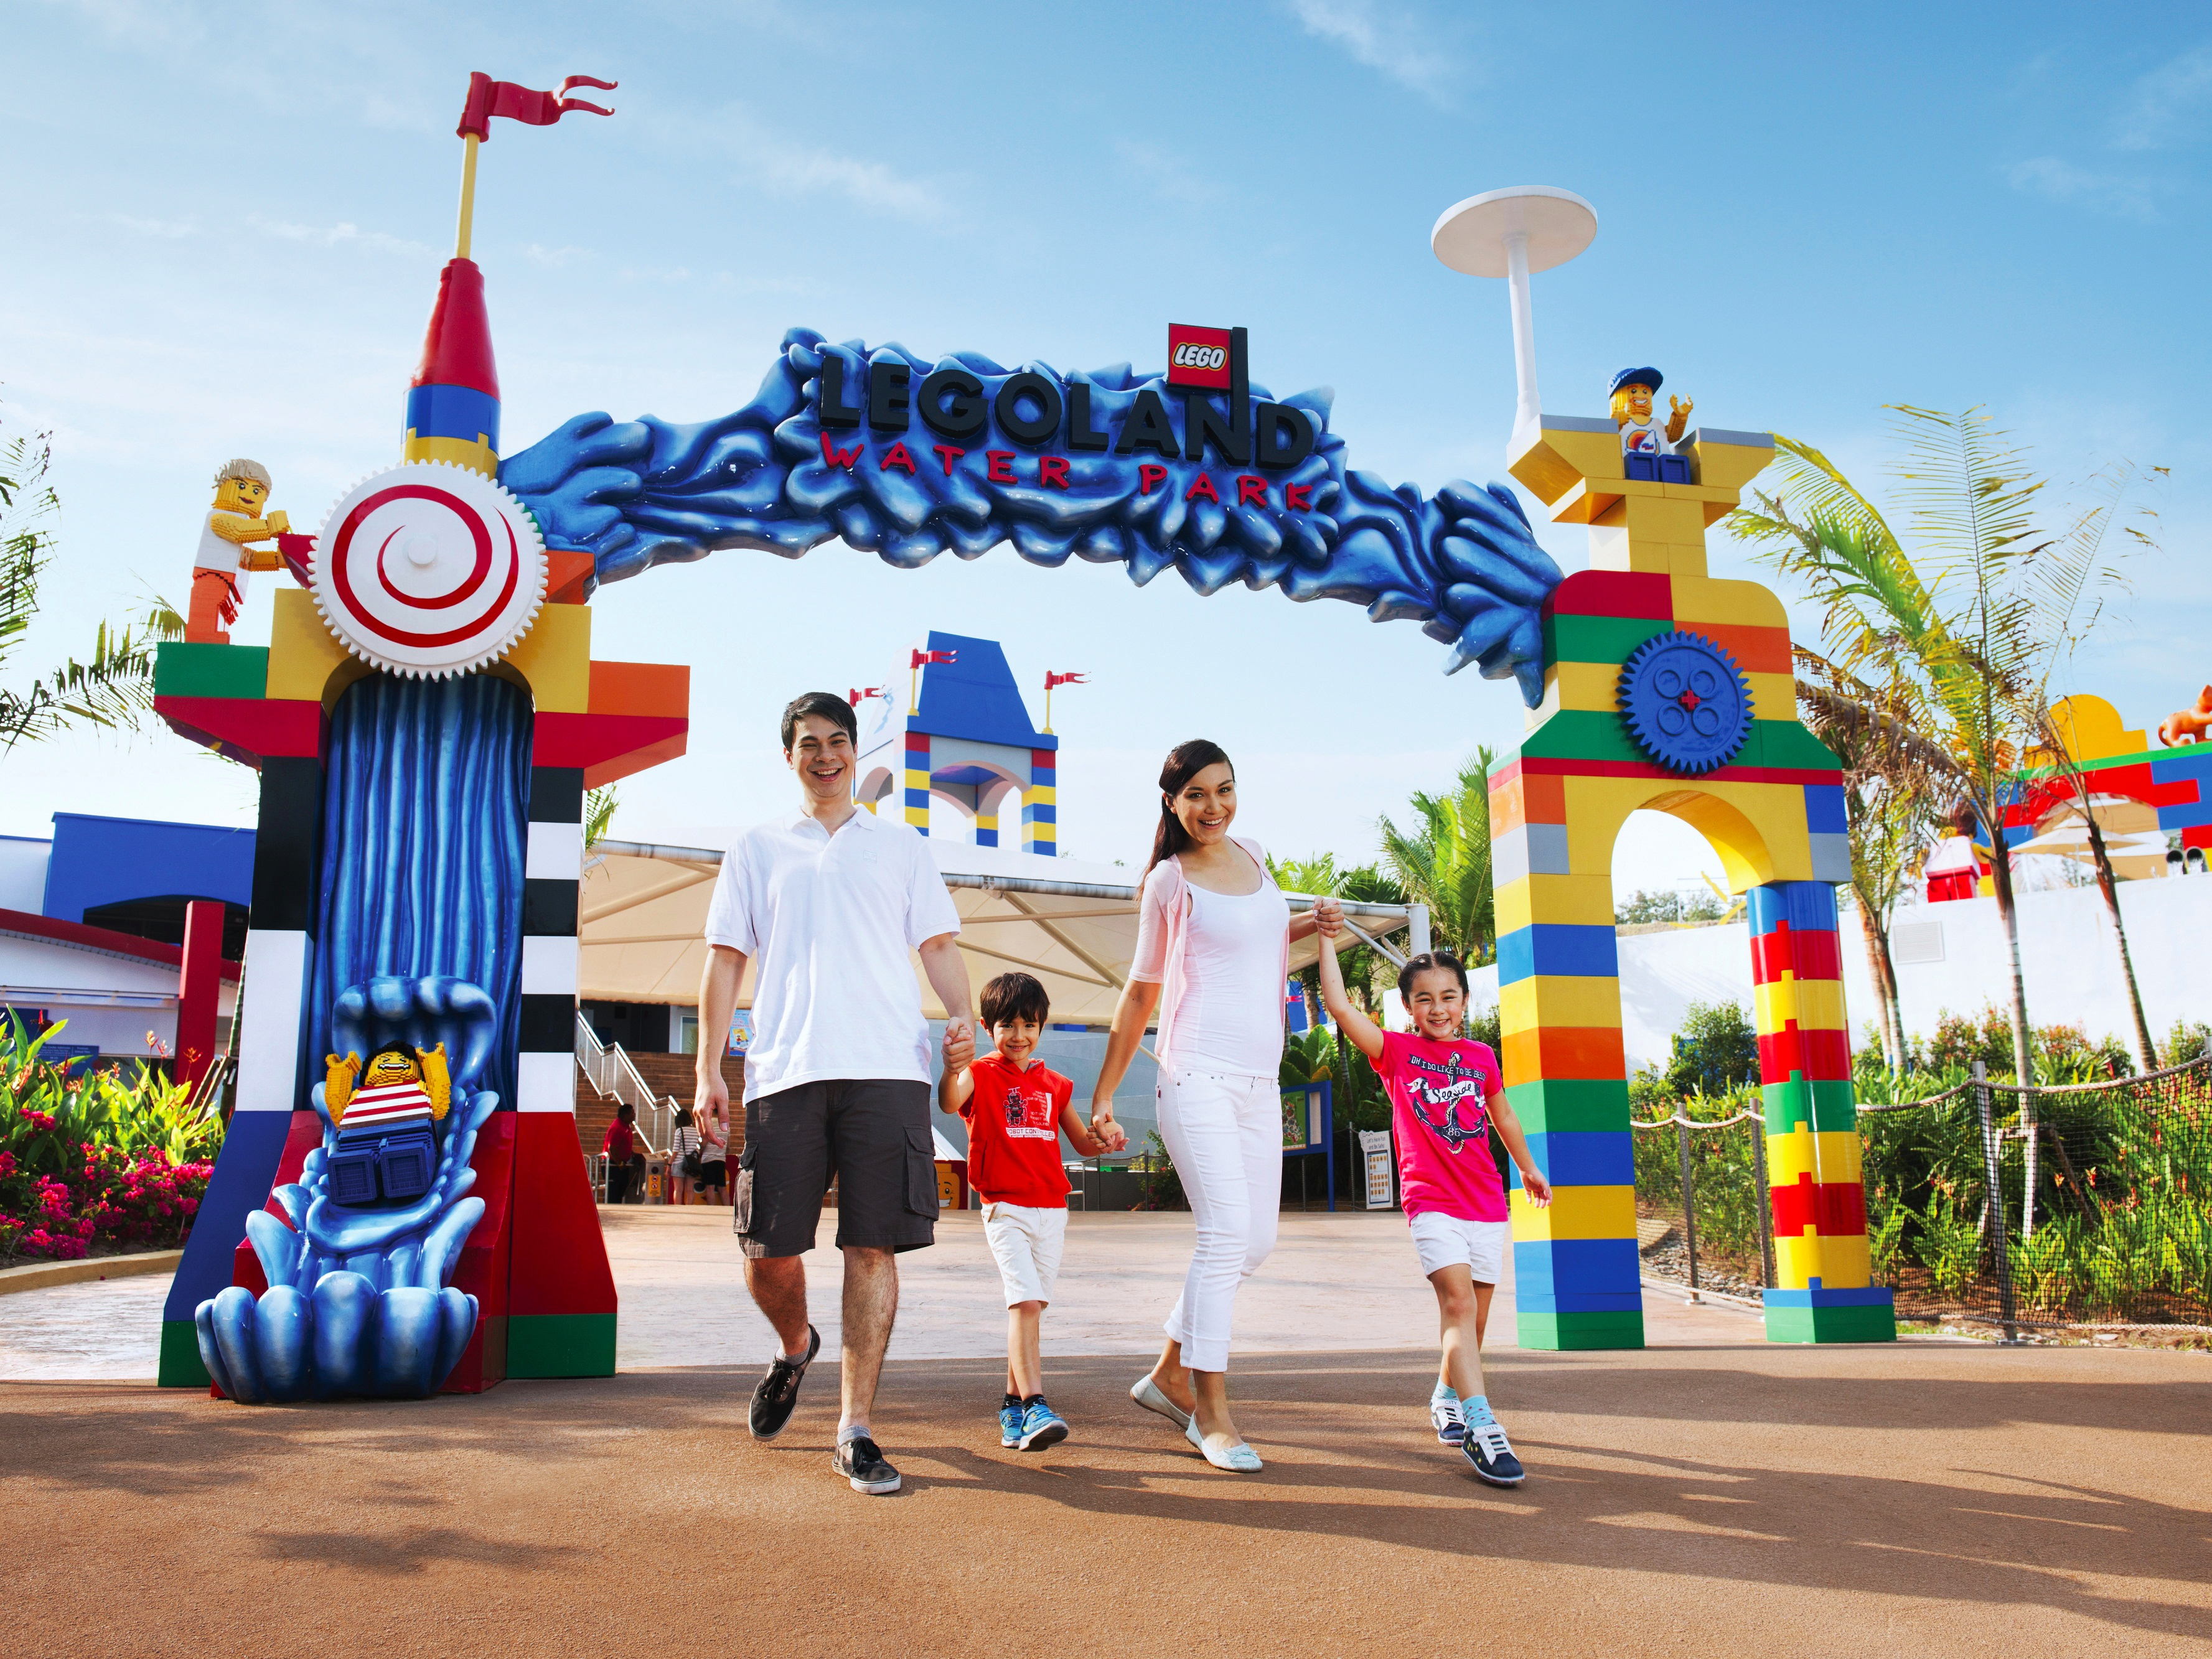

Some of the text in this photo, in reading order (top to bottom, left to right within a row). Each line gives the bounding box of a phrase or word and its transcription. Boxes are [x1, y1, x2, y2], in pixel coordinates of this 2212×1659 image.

[1174, 342, 1225, 371] LEGO
[820, 327, 1314, 470] LEGOLAND
[820, 431, 1313, 512] WATER PARK
[1411, 1056, 1421, 1065] OH
[1437, 1065, 1454, 1074] LIKE
[1465, 1068, 1472, 1077] BE
[1430, 1078, 1447, 1087] THE
[1432, 1081, 1472, 1104] Seaside
